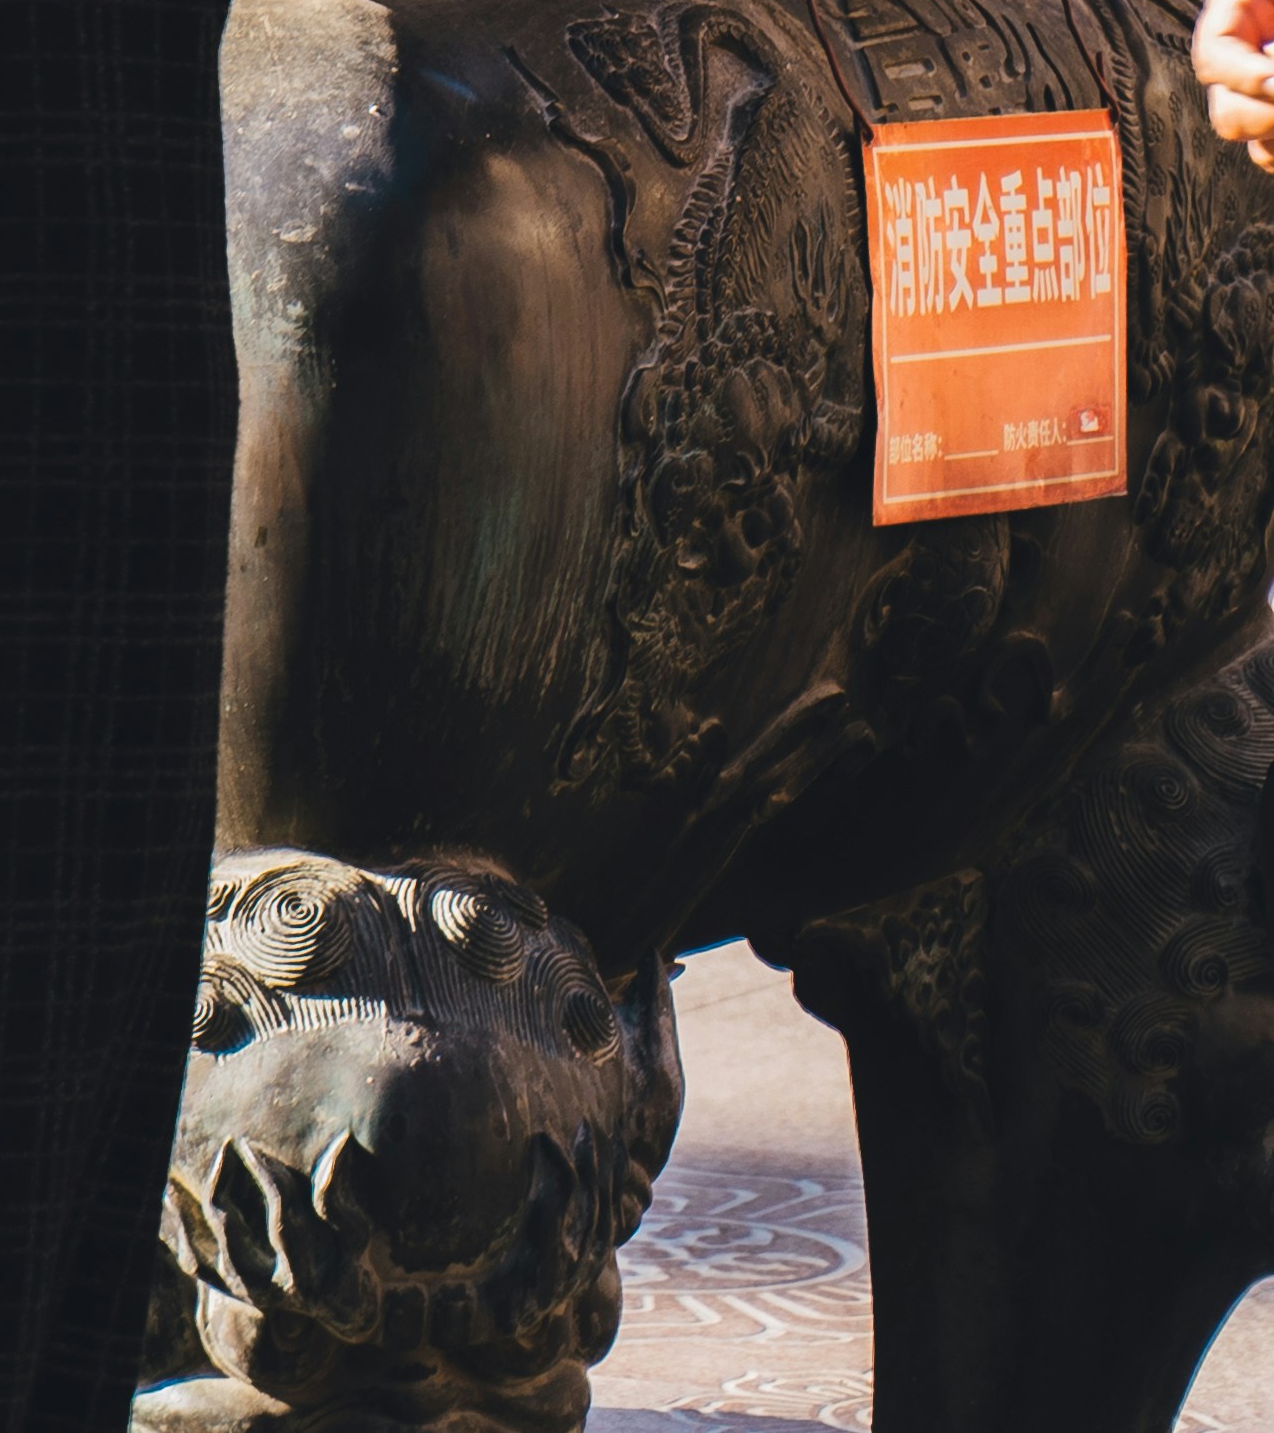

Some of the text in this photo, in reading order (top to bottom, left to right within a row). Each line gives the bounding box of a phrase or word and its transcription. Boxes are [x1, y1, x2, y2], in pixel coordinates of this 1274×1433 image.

[884, 163, 1112, 317] 消防安全重点部位
